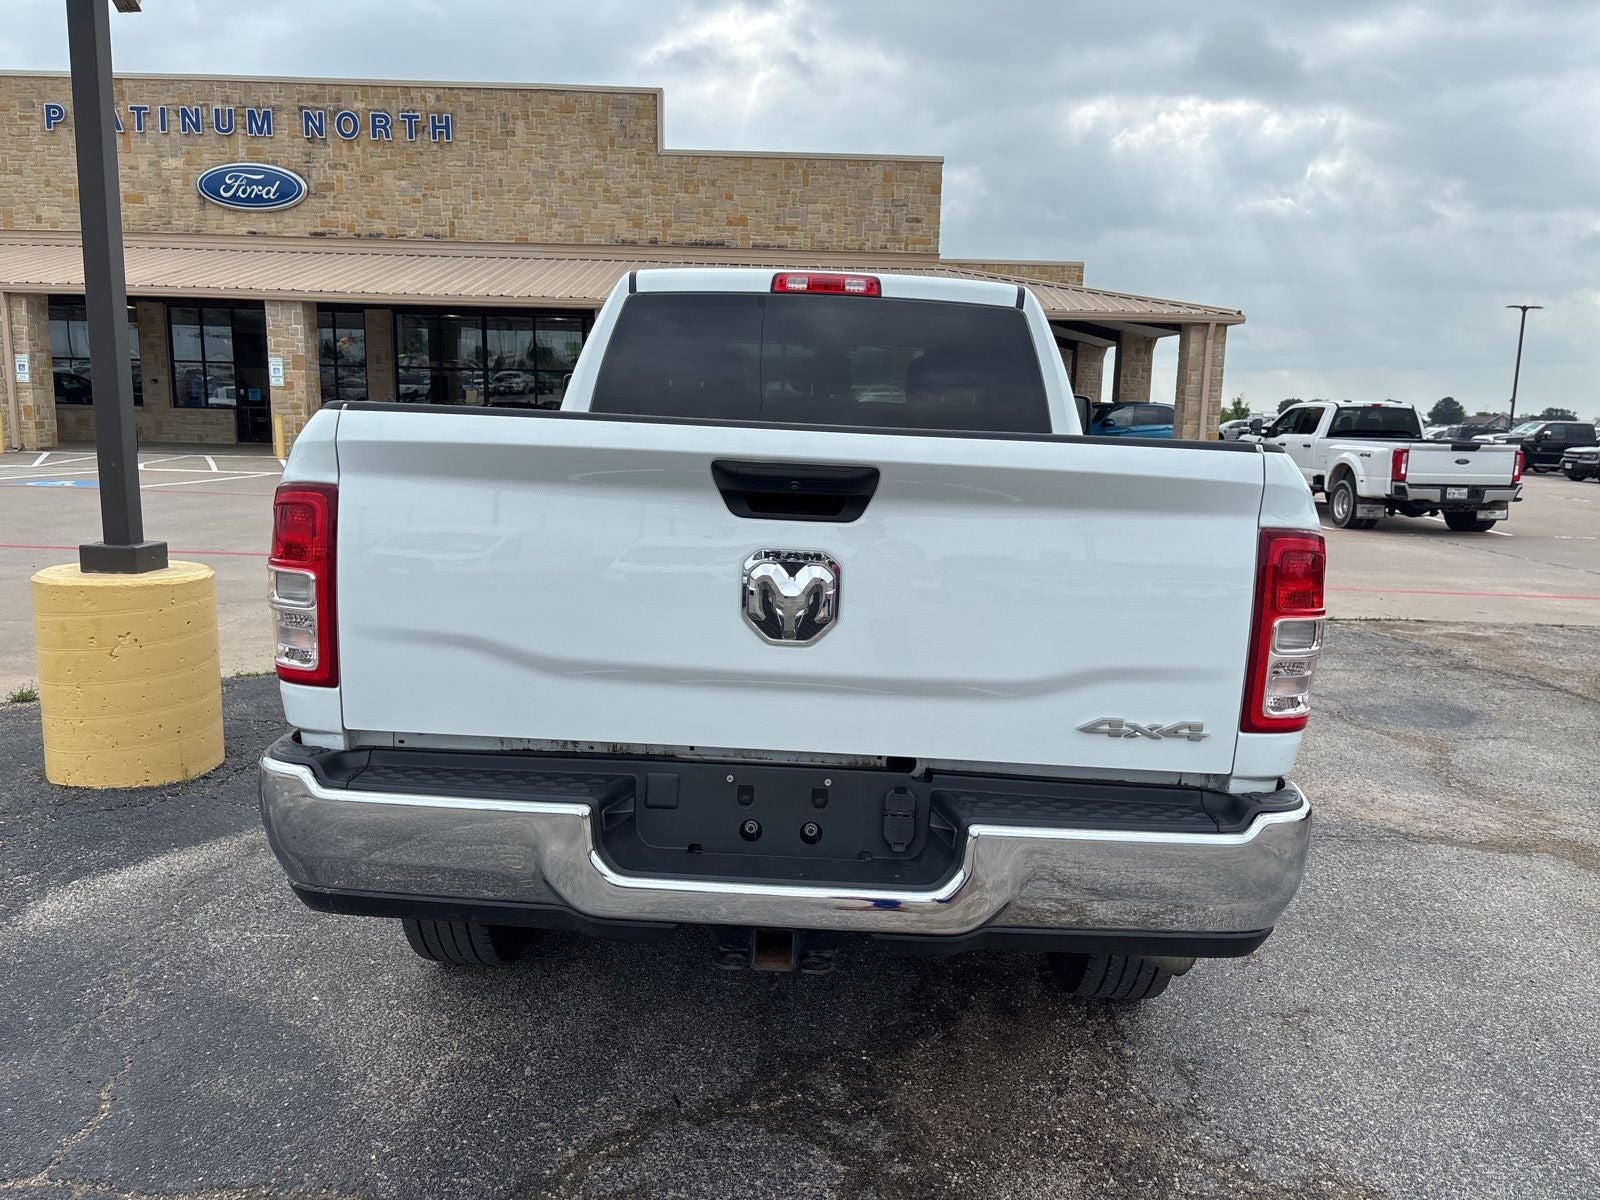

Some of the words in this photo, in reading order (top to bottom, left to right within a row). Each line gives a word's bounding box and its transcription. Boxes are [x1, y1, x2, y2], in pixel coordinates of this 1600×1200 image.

[43, 102, 273, 137] PTINUM
[302, 109, 453, 142] NORTH
[219, 172, 280, 199] Ford
[762, 550, 825, 561] RAM
